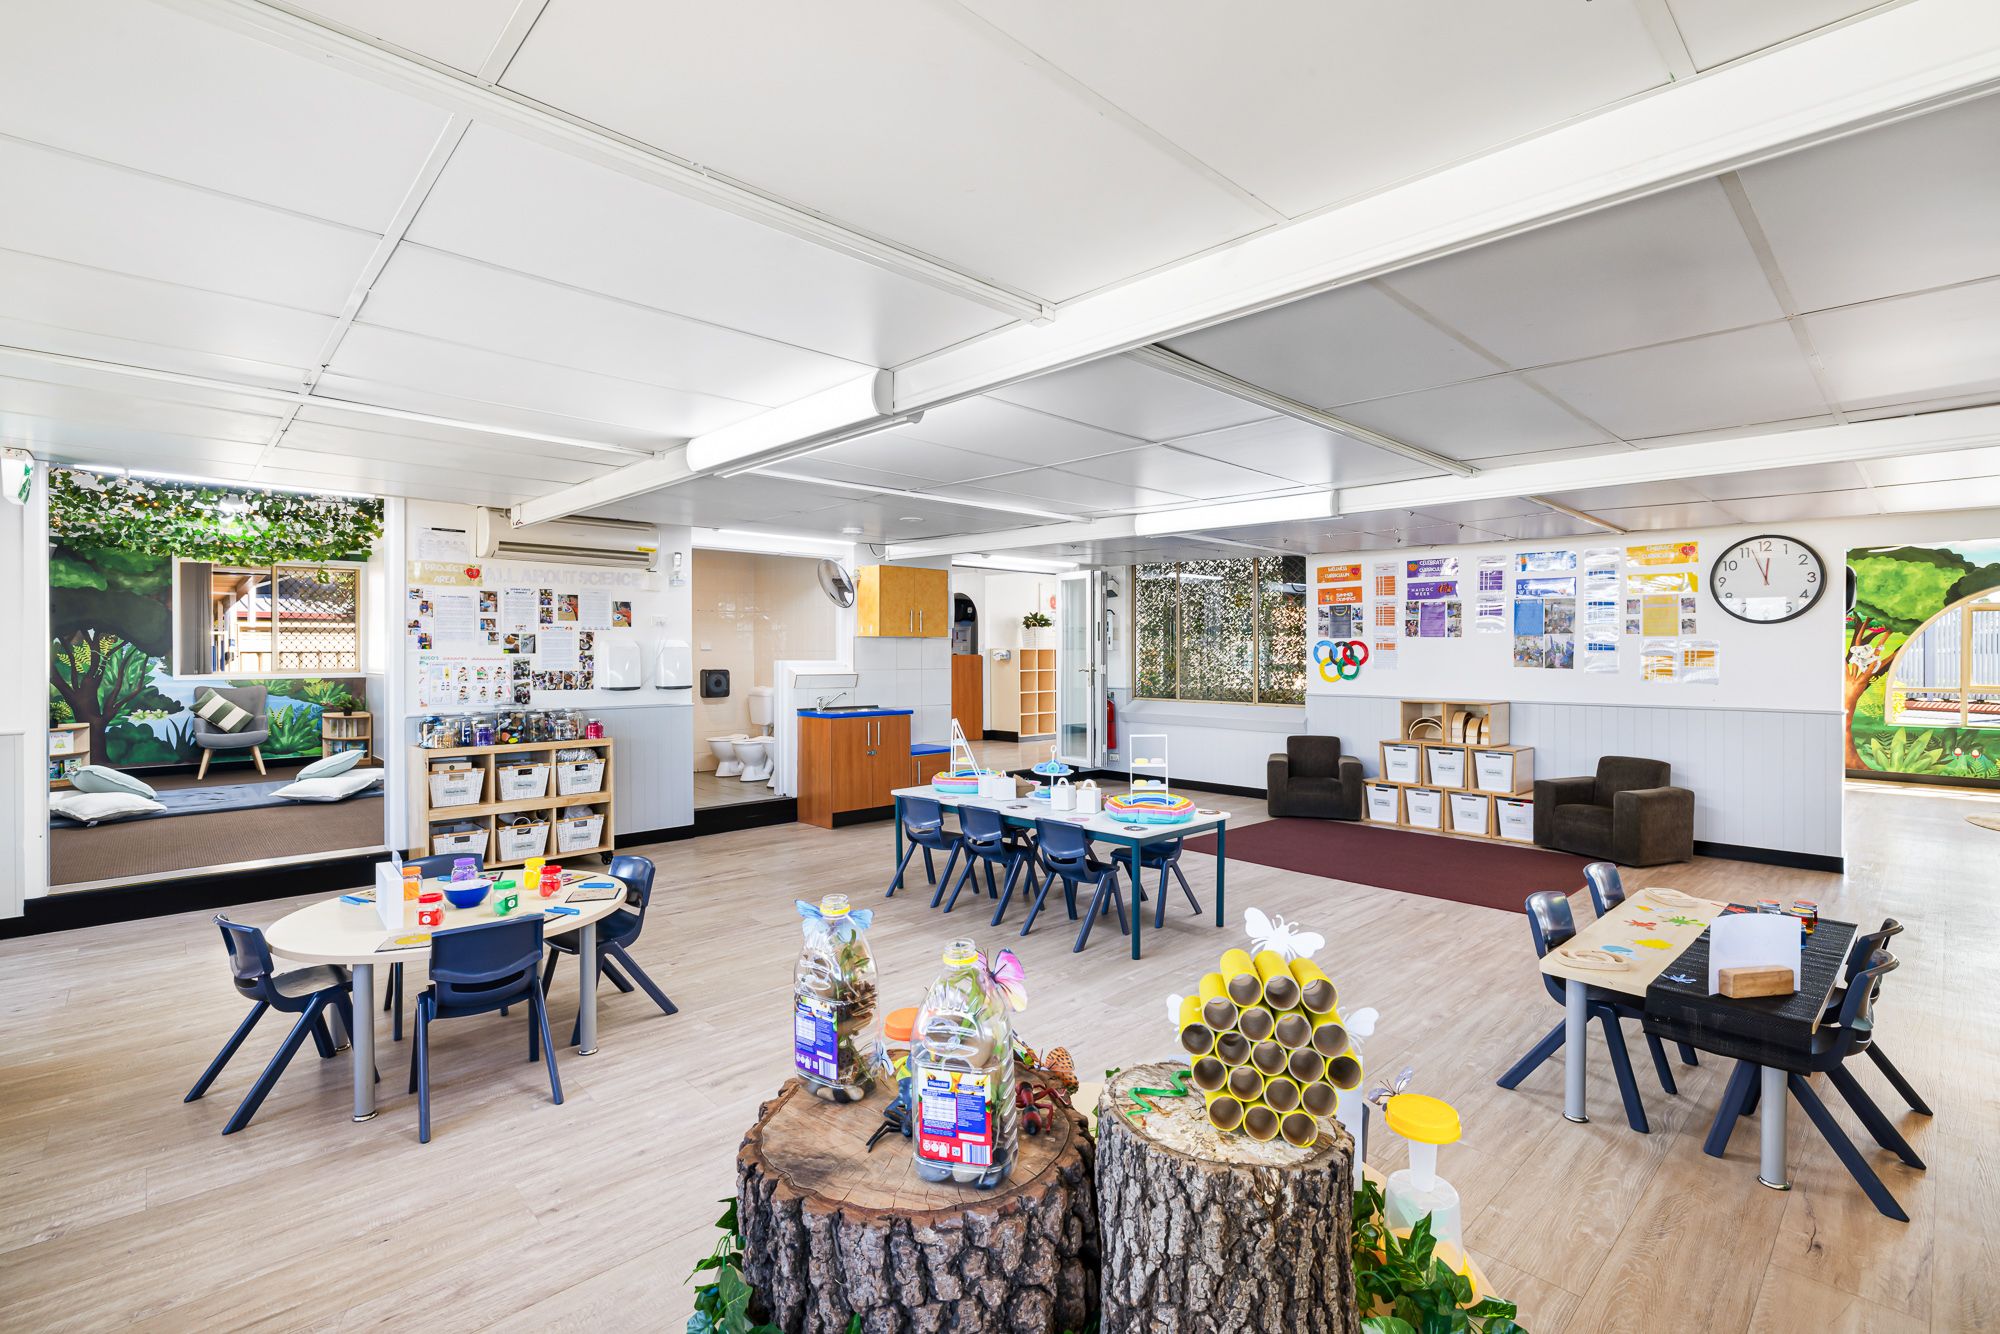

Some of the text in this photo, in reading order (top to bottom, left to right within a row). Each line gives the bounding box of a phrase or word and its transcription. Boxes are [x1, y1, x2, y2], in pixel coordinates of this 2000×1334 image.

[1758, 540, 1772, 552] 12
[1783, 543, 1788, 555] 1
[1740, 547, 1751, 558] 11
[1723, 560, 1738, 571] 10
[1798, 554, 1808, 566] 2
[484, 567, 641, 586] ALL ABOUT SCIENCE
[1718, 576, 1727, 588] 9
[1807, 571, 1817, 583] 3
[1799, 588, 1809, 599] 4
[1785, 602, 1793, 613] 5
